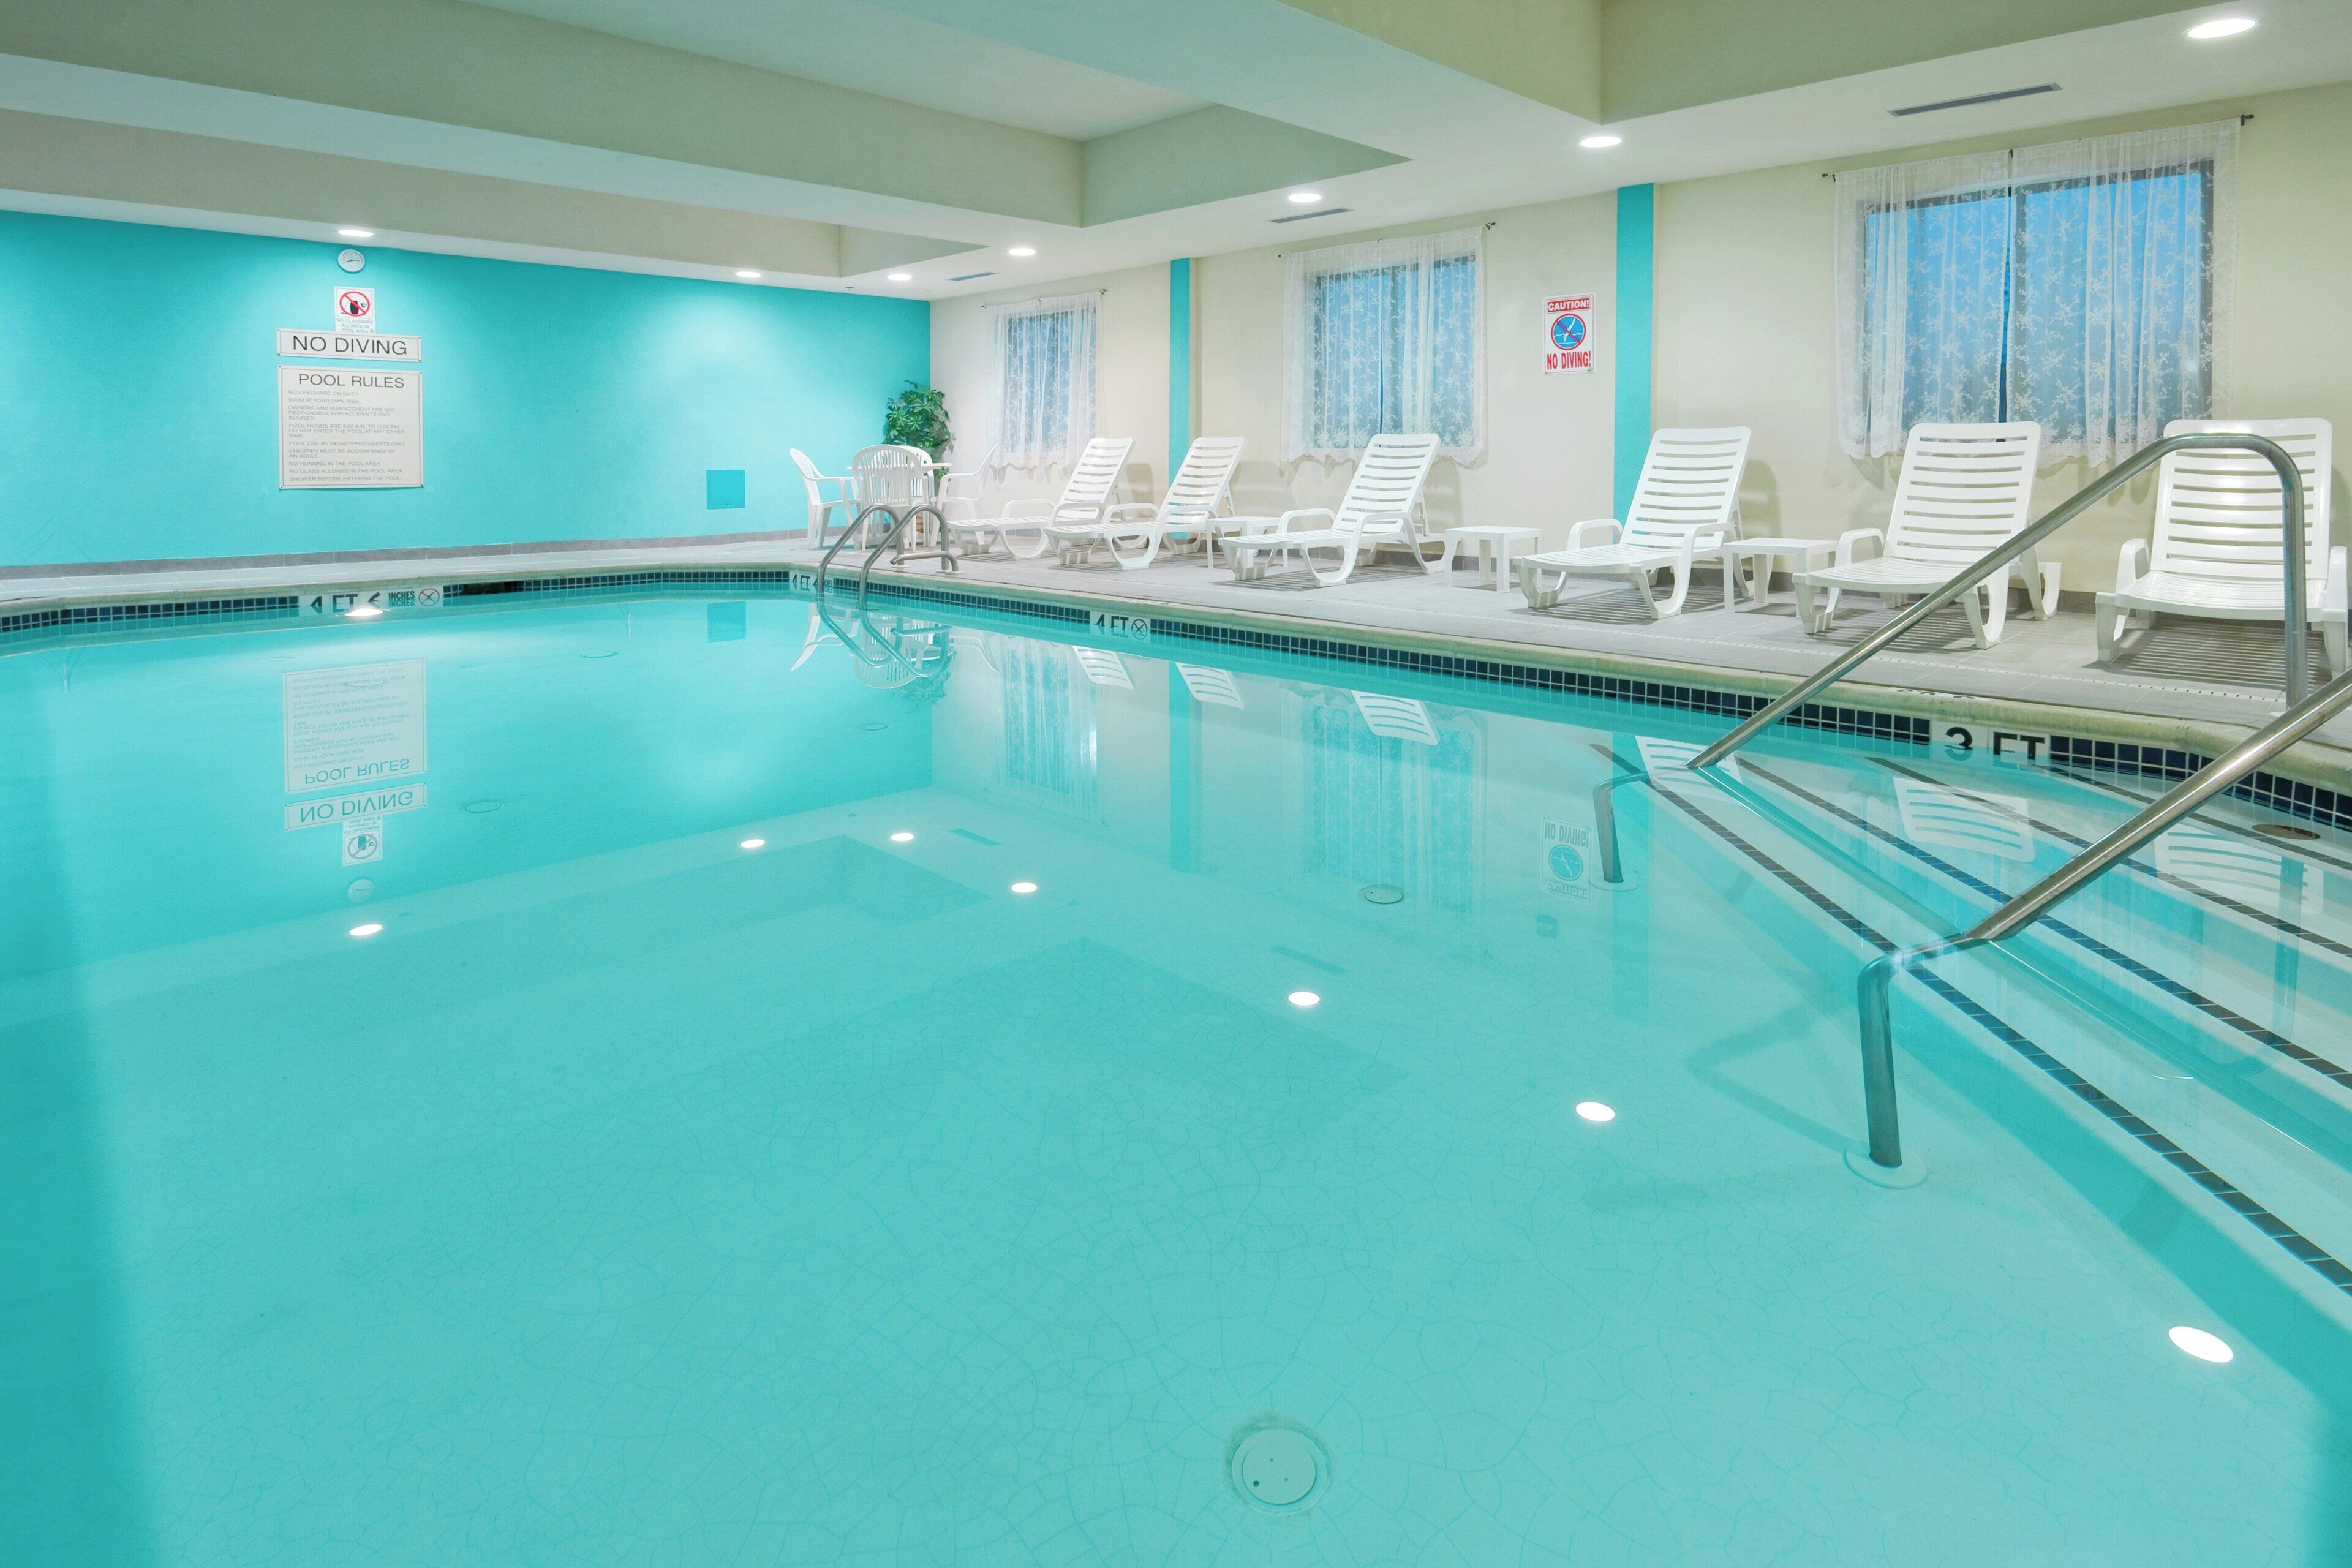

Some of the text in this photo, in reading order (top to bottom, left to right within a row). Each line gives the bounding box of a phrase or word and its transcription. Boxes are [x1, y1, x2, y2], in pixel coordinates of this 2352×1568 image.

[1548, 299, 1589, 311] CAUTION!
[293, 335, 407, 355] NO DIVING
[1547, 350, 1591, 370] NO DIVING!
[298, 374, 404, 388] POOL RULES
[388, 590, 415, 600] INCHES
[1110, 616, 1129, 630] FT
[1993, 731, 2045, 760] FT
